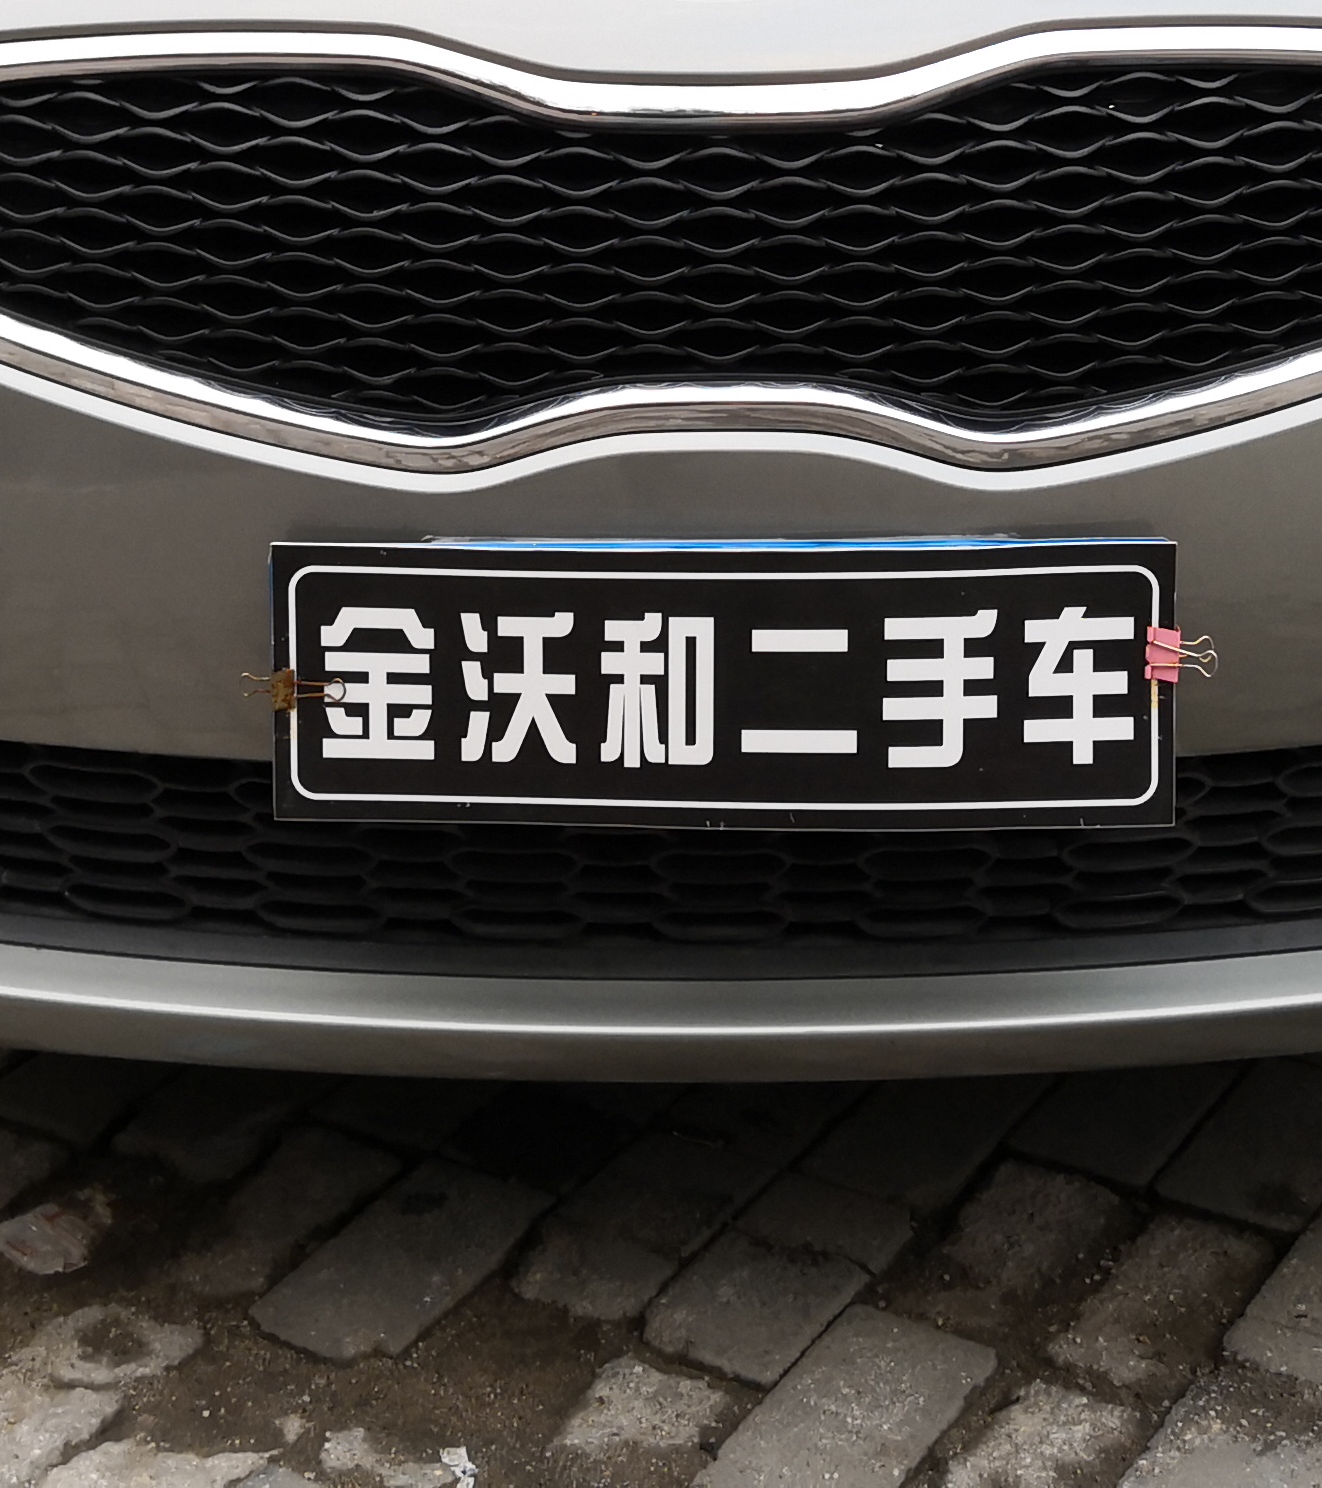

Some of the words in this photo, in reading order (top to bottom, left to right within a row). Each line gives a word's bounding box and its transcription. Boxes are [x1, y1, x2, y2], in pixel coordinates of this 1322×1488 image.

[319, 606, 1136, 768] 金沃和二手车
